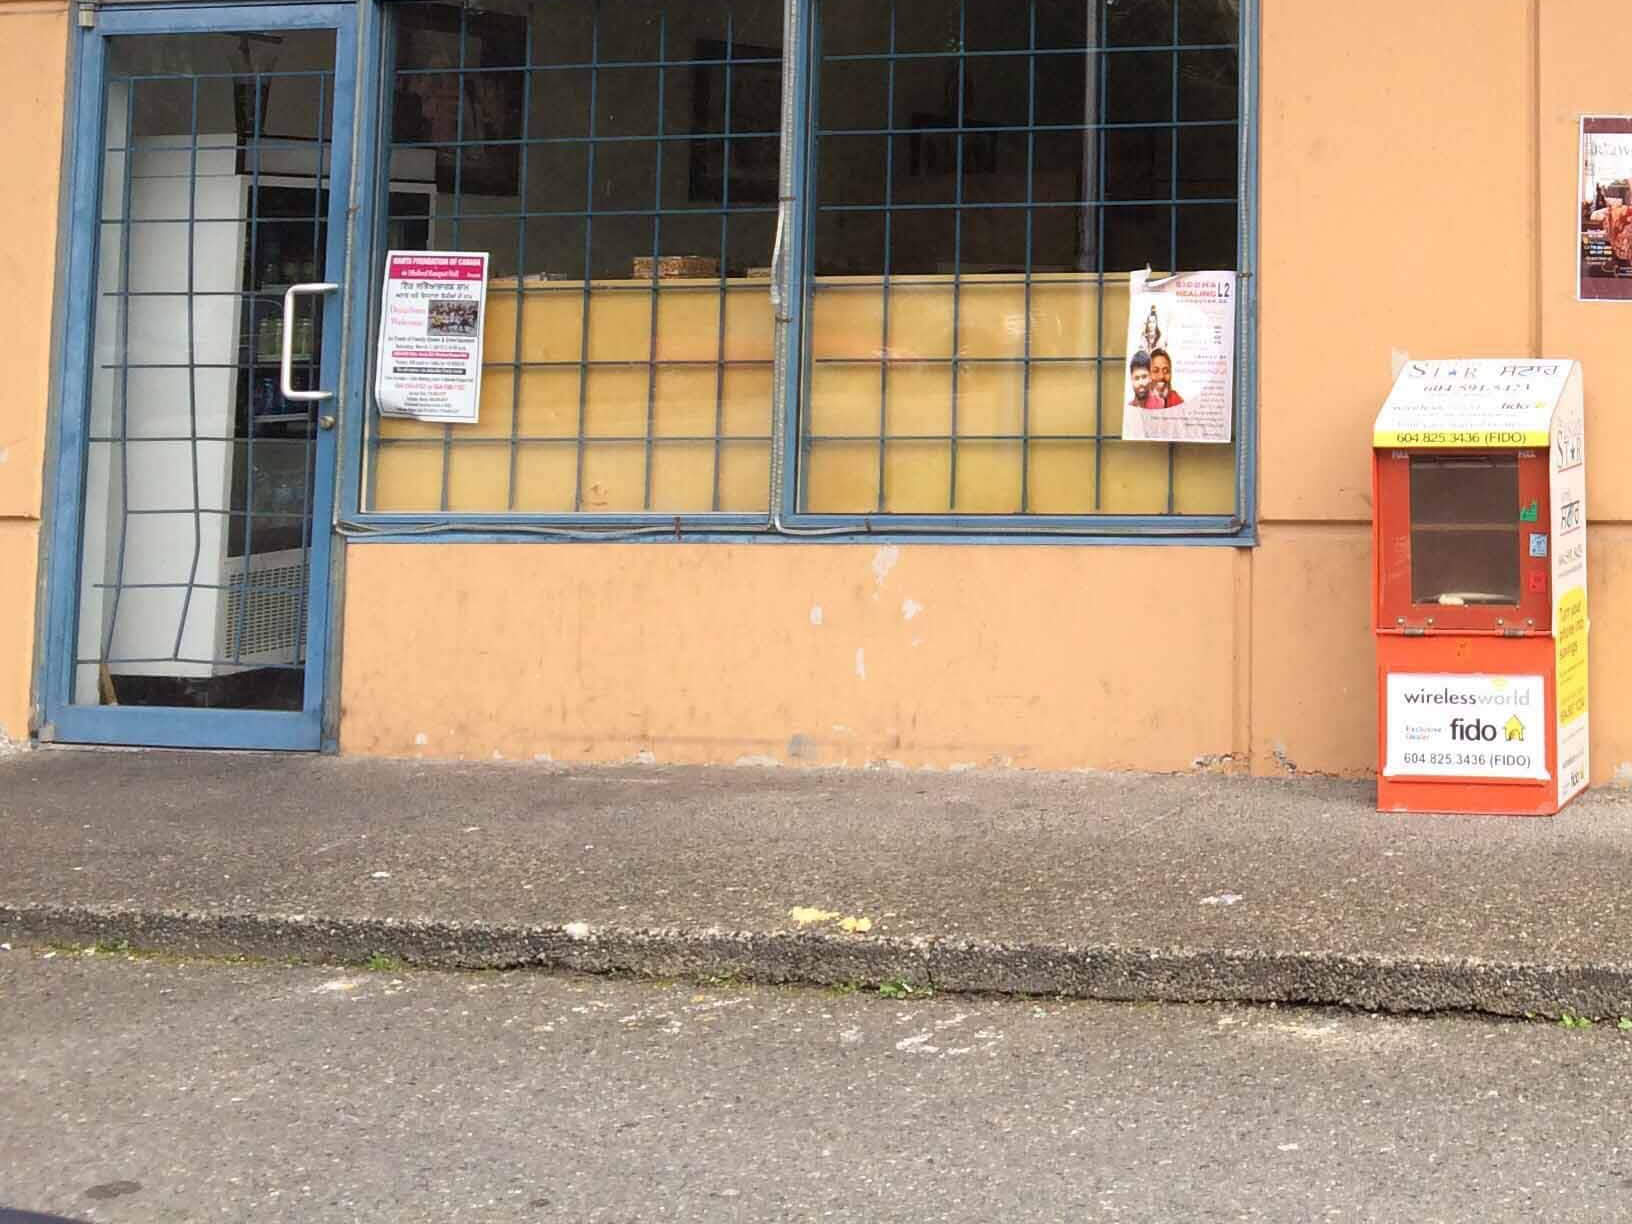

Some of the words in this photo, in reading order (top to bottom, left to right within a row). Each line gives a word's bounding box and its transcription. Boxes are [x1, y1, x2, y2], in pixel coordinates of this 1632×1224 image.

[1484, 431, 1527, 444] (FIDO)
[1450, 717, 1497, 741] fido
[1489, 754, 1532, 769] (FIDO)
